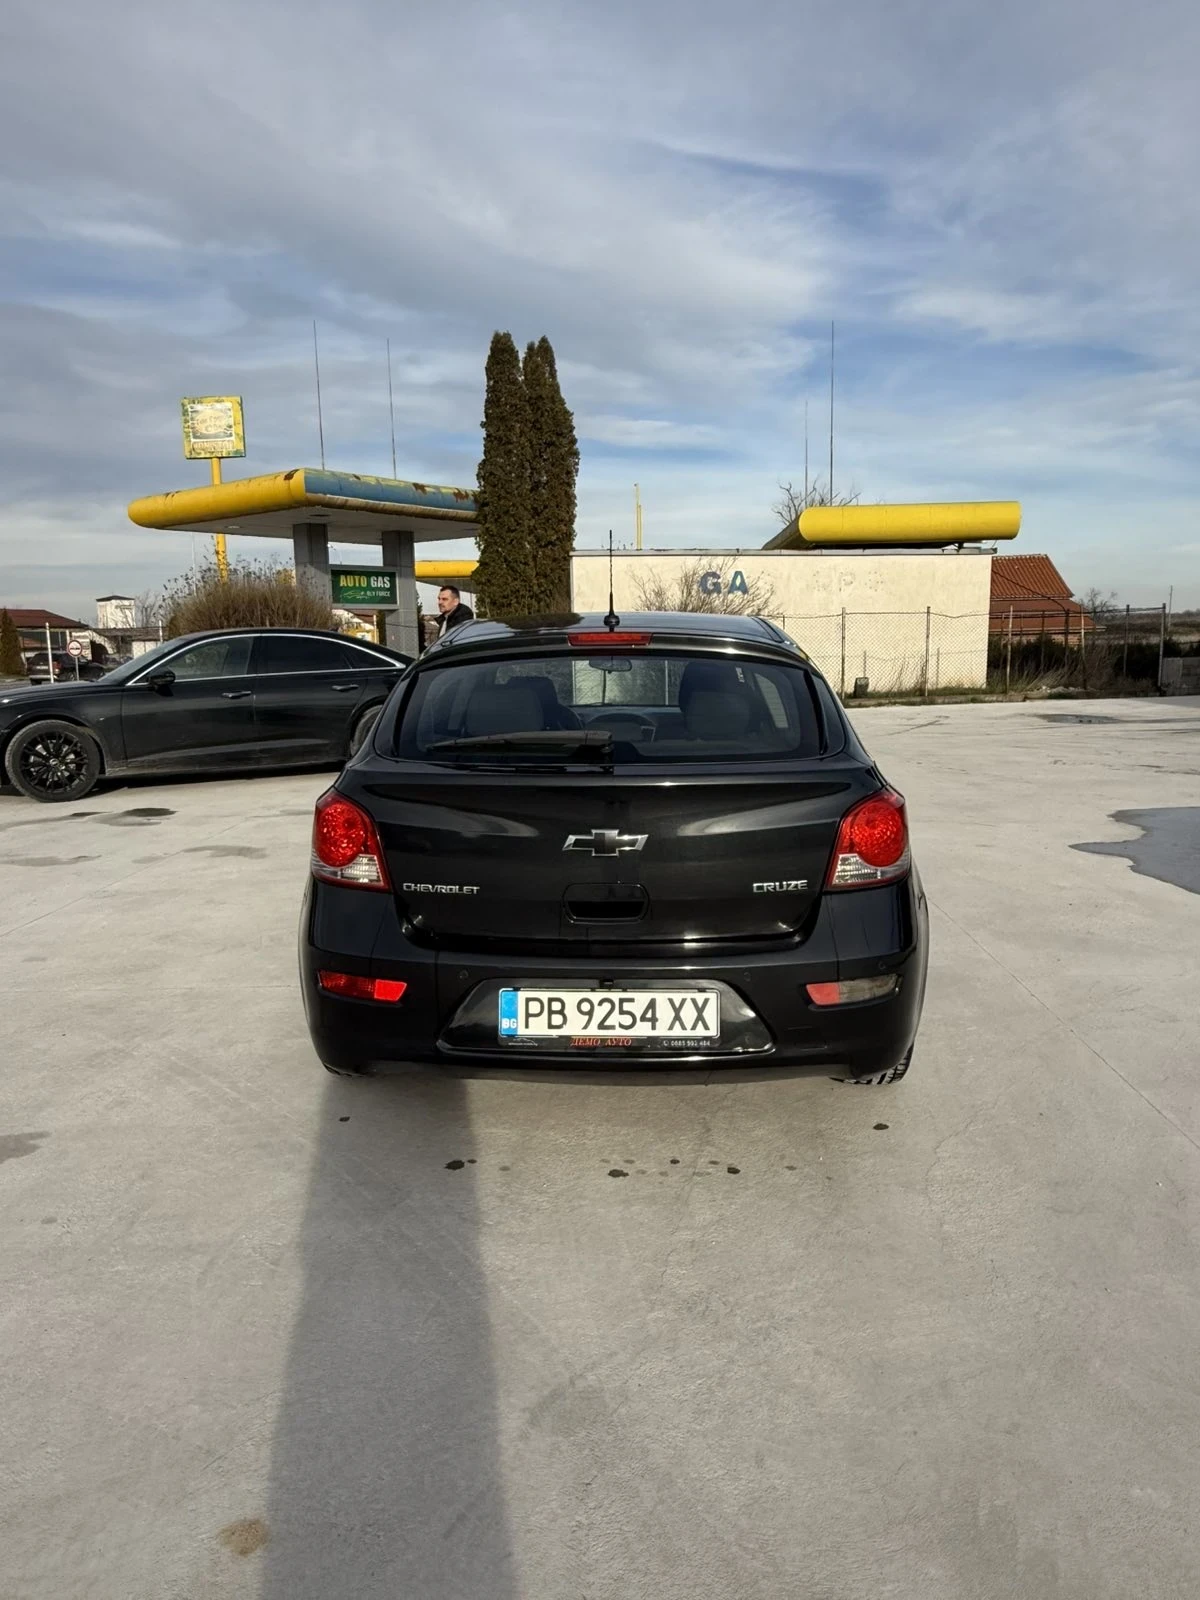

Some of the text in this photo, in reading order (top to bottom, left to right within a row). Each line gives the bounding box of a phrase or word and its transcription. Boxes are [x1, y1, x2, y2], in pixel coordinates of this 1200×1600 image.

[340, 575, 391, 588] AUTO GAS
[700, 571, 749, 594] GA
[403, 883, 480, 895] CHEVROLET
[753, 880, 808, 893] CRUZE
[502, 997, 710, 1031] BG PB 9254 XX
